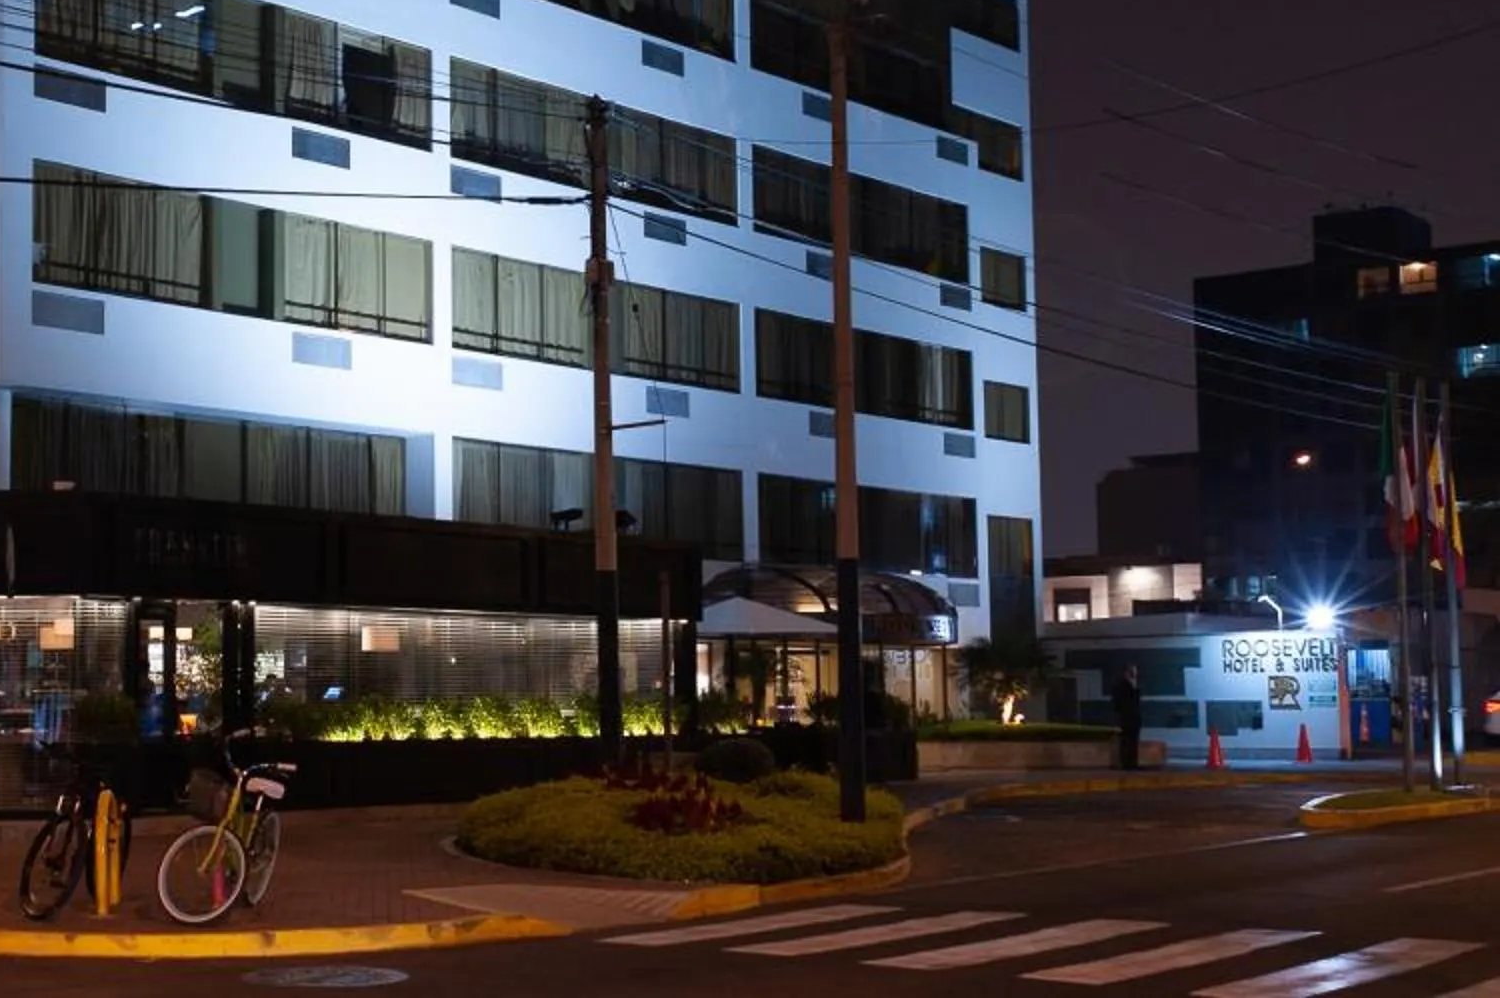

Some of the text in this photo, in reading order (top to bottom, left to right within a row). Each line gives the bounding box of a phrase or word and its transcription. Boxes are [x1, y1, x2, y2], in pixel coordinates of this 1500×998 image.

[1222, 638, 1338, 658] ROOSEVELT
[1223, 658, 1339, 673] HOTEL & SUITES
